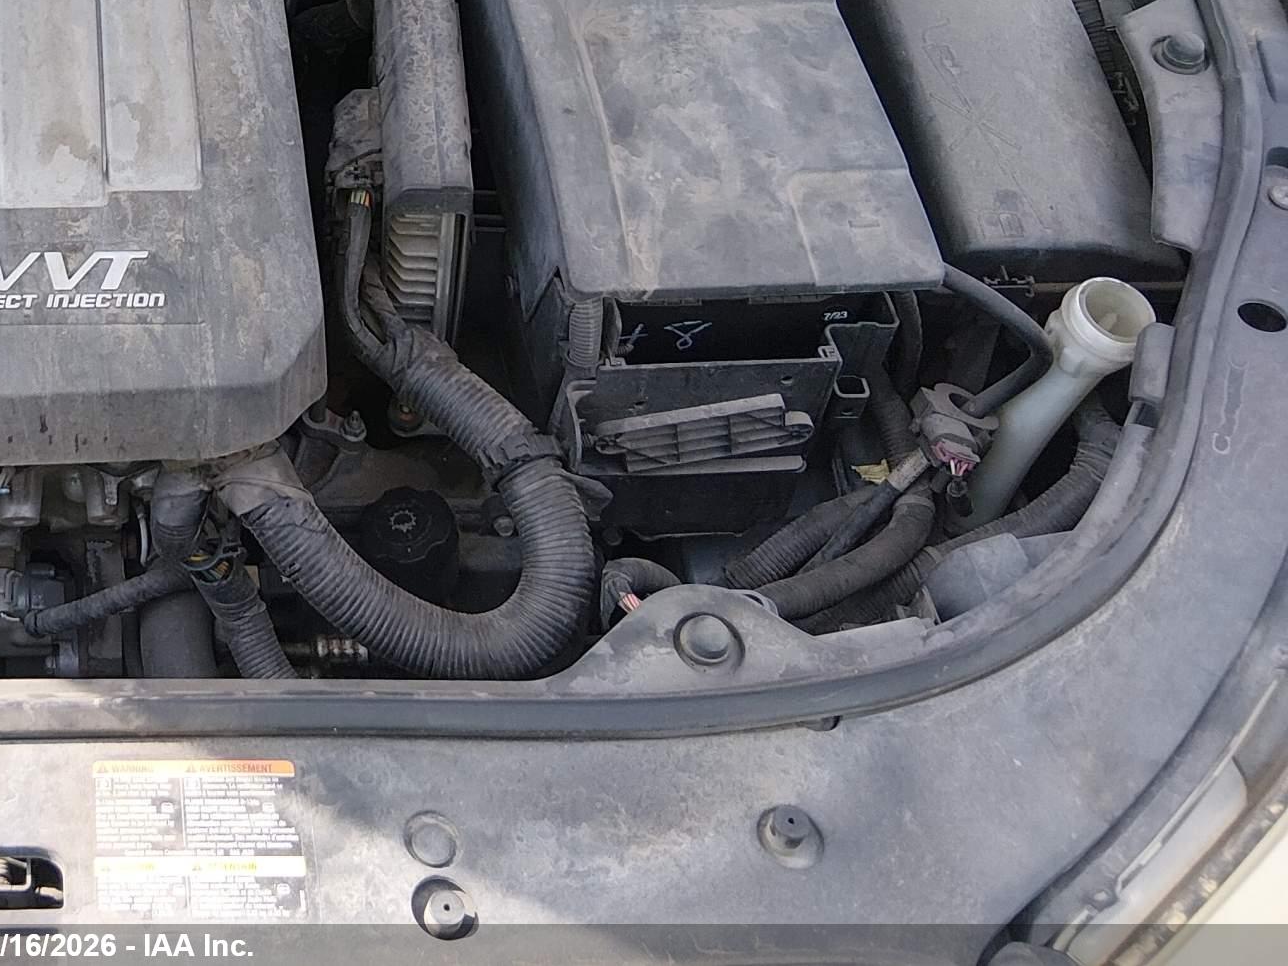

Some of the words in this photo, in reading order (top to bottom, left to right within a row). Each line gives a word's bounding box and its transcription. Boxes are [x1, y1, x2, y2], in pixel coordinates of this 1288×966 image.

[46, 293, 165, 308] INJECTION
[823, 311, 848, 321] 7/23
[198, 763, 273, 773] AVERTISSEMENT
